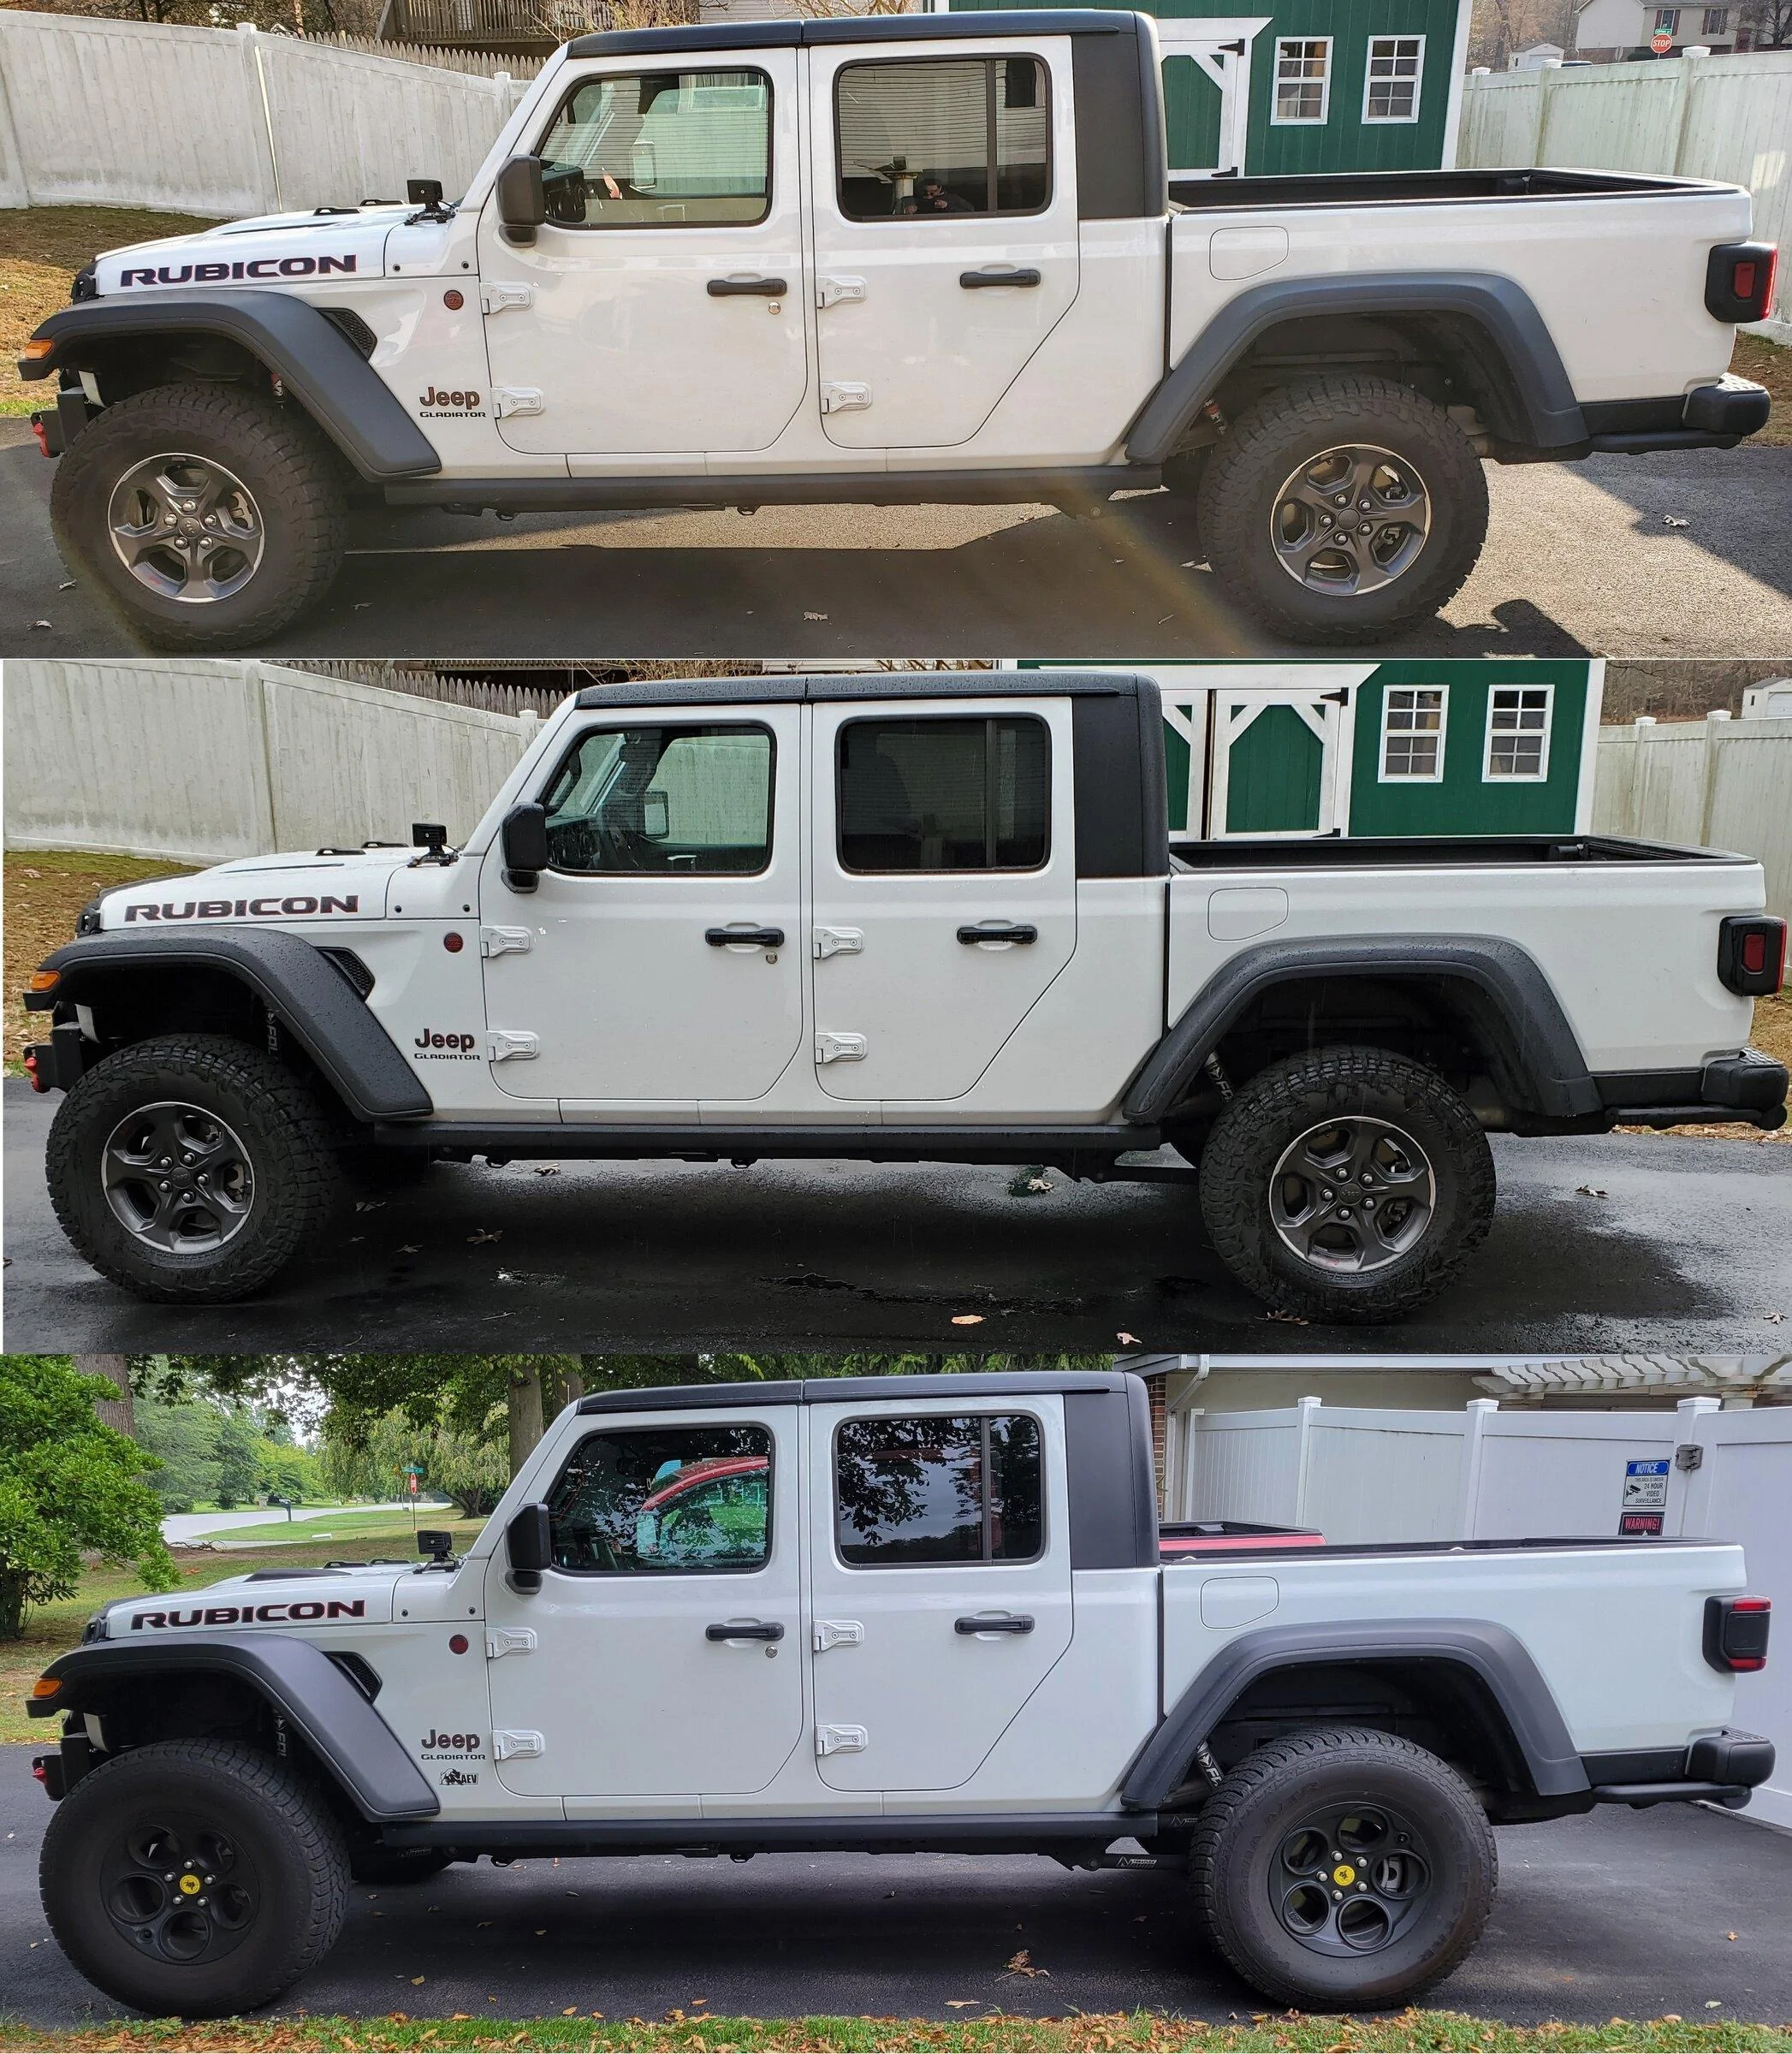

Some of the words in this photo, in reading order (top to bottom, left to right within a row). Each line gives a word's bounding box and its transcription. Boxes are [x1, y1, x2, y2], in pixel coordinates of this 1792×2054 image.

[120, 254, 357, 288] RUBICON
[419, 386, 480, 410] Jeep
[124, 894, 359, 923] RUBICON
[414, 1027, 475, 1053] Jeep
[1635, 1463, 1659, 1474] NOTICE
[1625, 1517, 1659, 1530] WARNING!
[130, 1600, 365, 1630] RUBICON
[421, 1729, 481, 1753] Jeep
[462, 1774, 478, 1784] AEV
